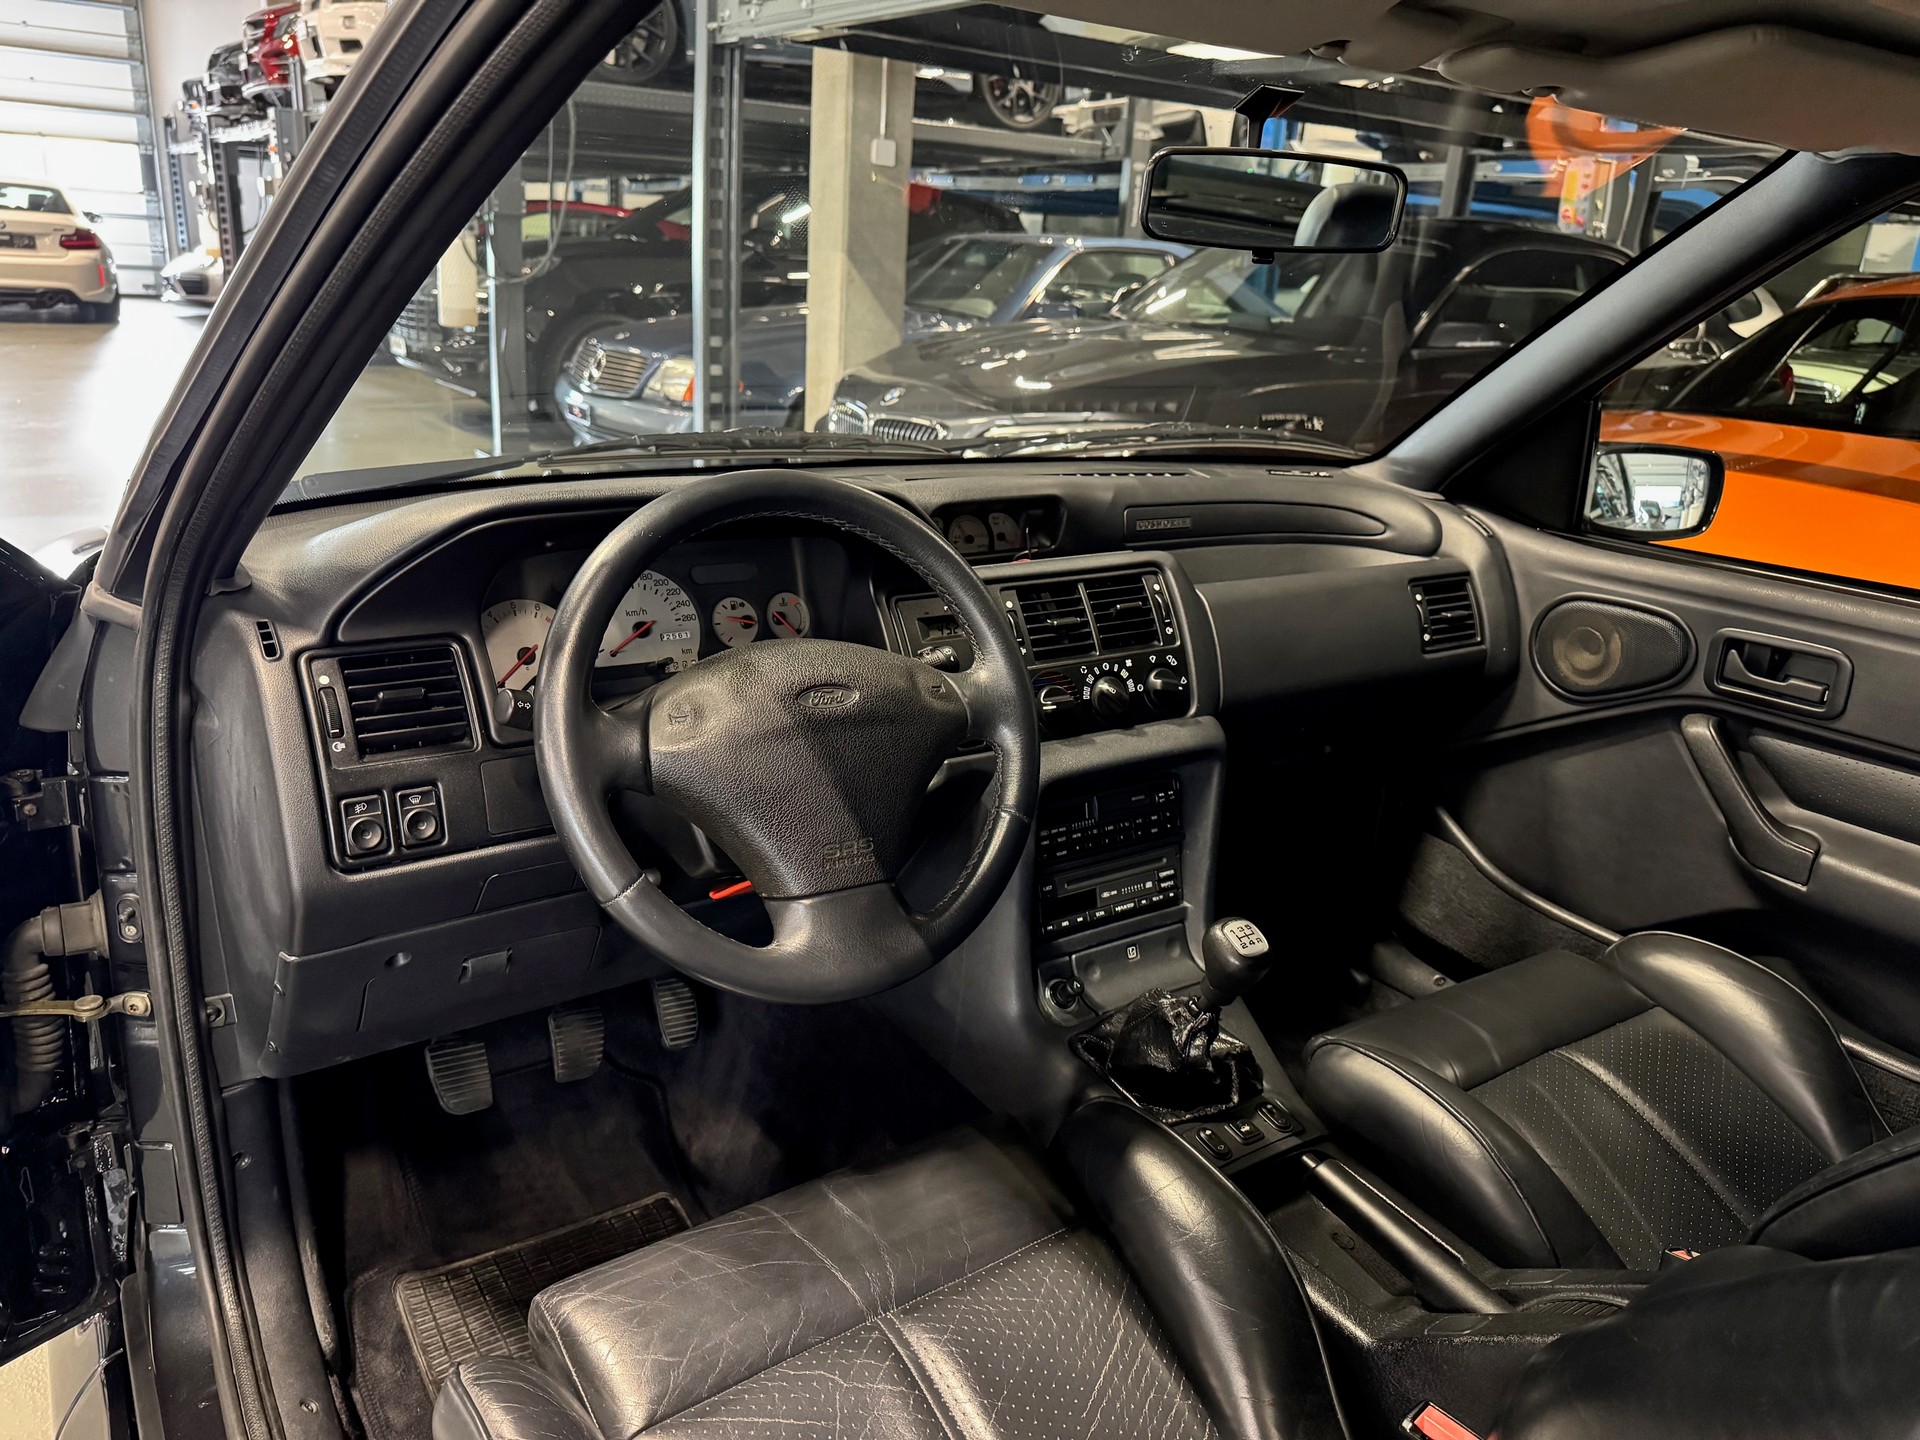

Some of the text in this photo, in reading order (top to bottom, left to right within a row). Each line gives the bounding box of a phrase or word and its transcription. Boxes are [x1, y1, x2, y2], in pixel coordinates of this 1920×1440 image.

[653, 578, 669, 587] 200
[665, 587, 681, 596] 220
[510, 601, 517, 610] 5
[534, 603, 541, 611] 6
[675, 599, 691, 608] 240
[625, 606, 648, 617] km/h
[681, 613, 697, 622] 260
[681, 647, 693, 655] km
[809, 688, 845, 707] Ford
